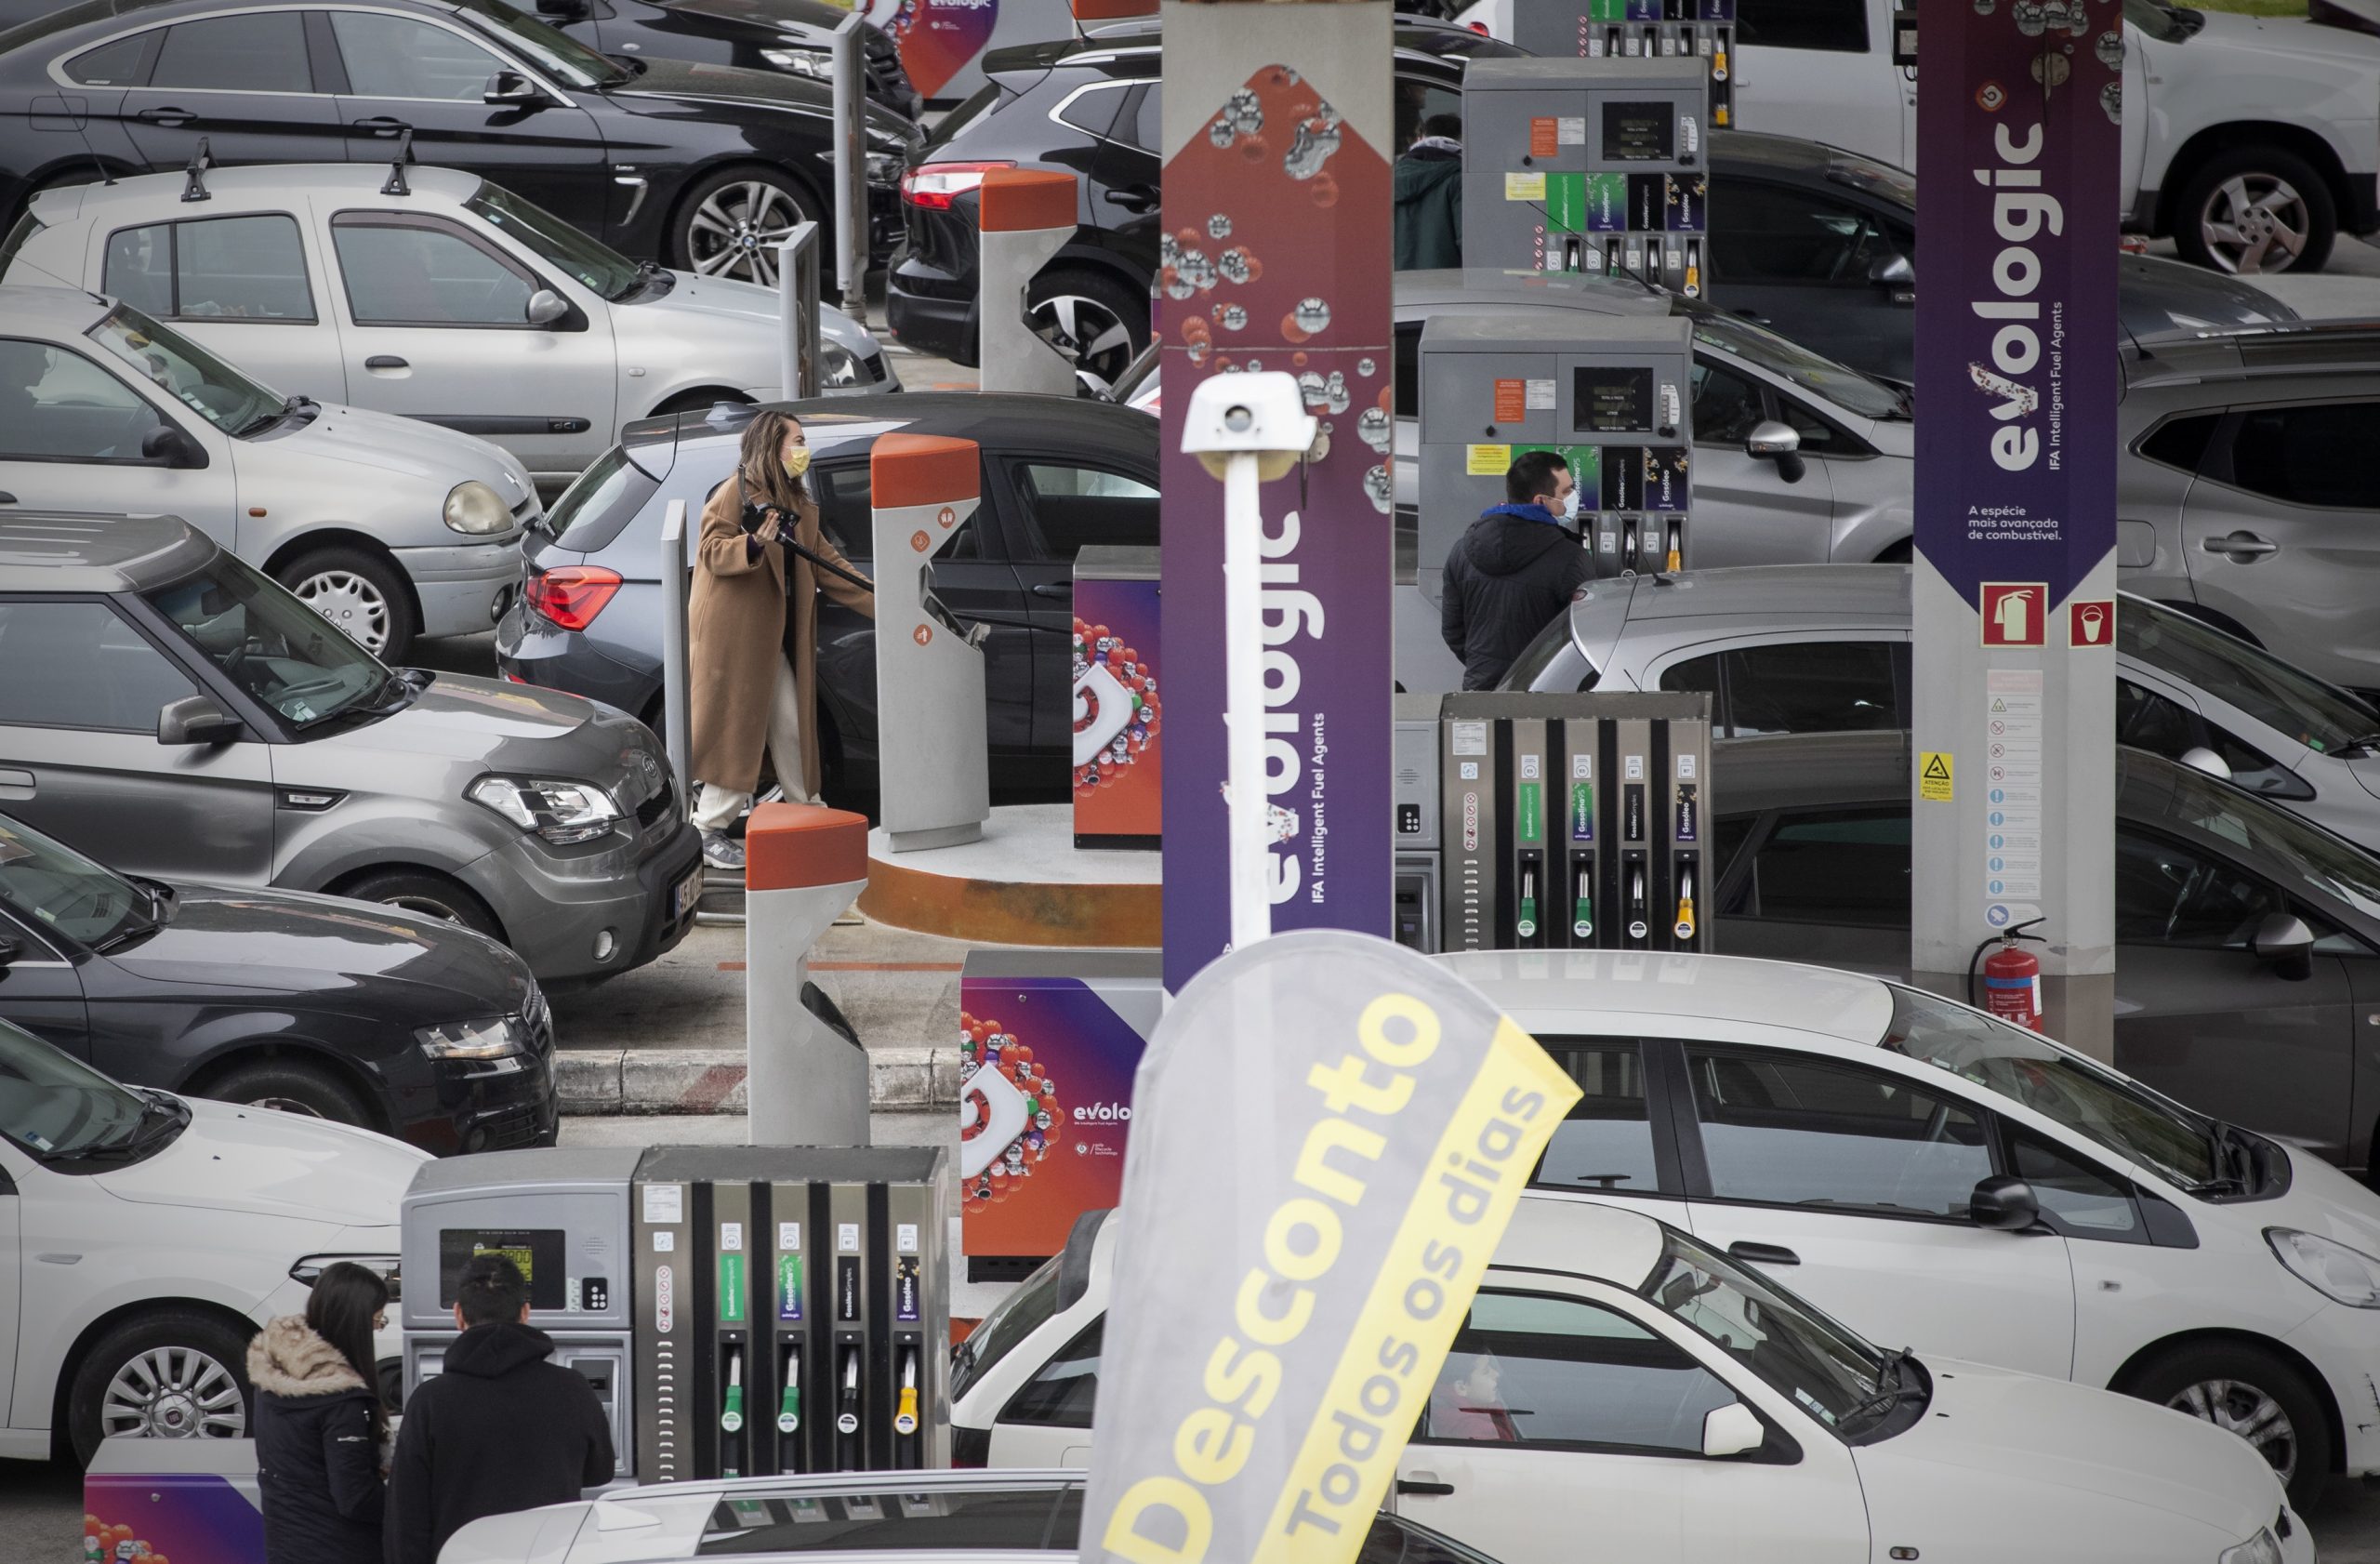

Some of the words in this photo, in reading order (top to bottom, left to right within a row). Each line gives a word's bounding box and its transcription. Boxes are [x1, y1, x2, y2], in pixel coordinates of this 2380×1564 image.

[1971, 124, 2064, 471] evologic
[2050, 302, 2064, 348] Agents
[2050, 352, 2060, 378] Fuel
[2050, 382, 2064, 446] Intelligent
[2050, 450, 2060, 471] IFA
[1968, 506, 1978, 515] A
[1981, 506, 2027, 518] espécie
[1968, 518, 1998, 527] mais
[2000, 518, 2058, 529] avançada
[1968, 530, 1983, 539] de
[1986, 529, 2062, 540] combustível.
[1312, 712, 1329, 765] Agents
[1312, 768, 1324, 799] Fuel
[1312, 802, 1329, 876] Intelligent
[1312, 880, 1324, 904] IFA
[903, 1277, 911, 1312] Gasóleo
[1102, 992, 1441, 1564] Desconto
[1284, 1334, 1418, 1536] Todos
[1404, 1239, 1463, 1321] os
[1440, 1084, 1545, 1226] dias
